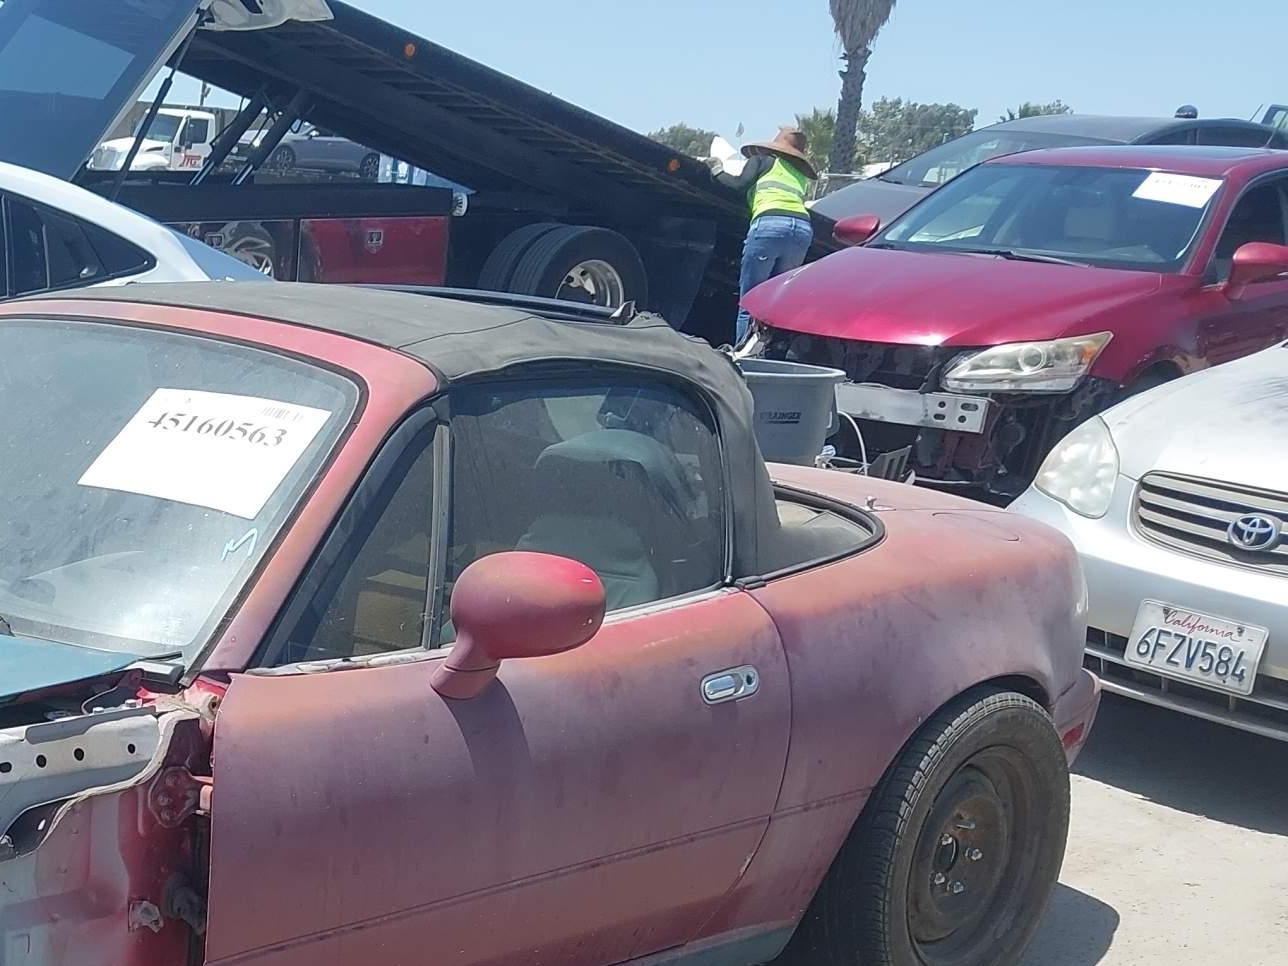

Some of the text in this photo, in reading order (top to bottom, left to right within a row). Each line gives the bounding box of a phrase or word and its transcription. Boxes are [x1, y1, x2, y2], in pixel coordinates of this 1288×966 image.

[148, 411, 288, 448] 45160563
[1164, 610, 1240, 643] California
[1136, 627, 1246, 683] 6FZV584
